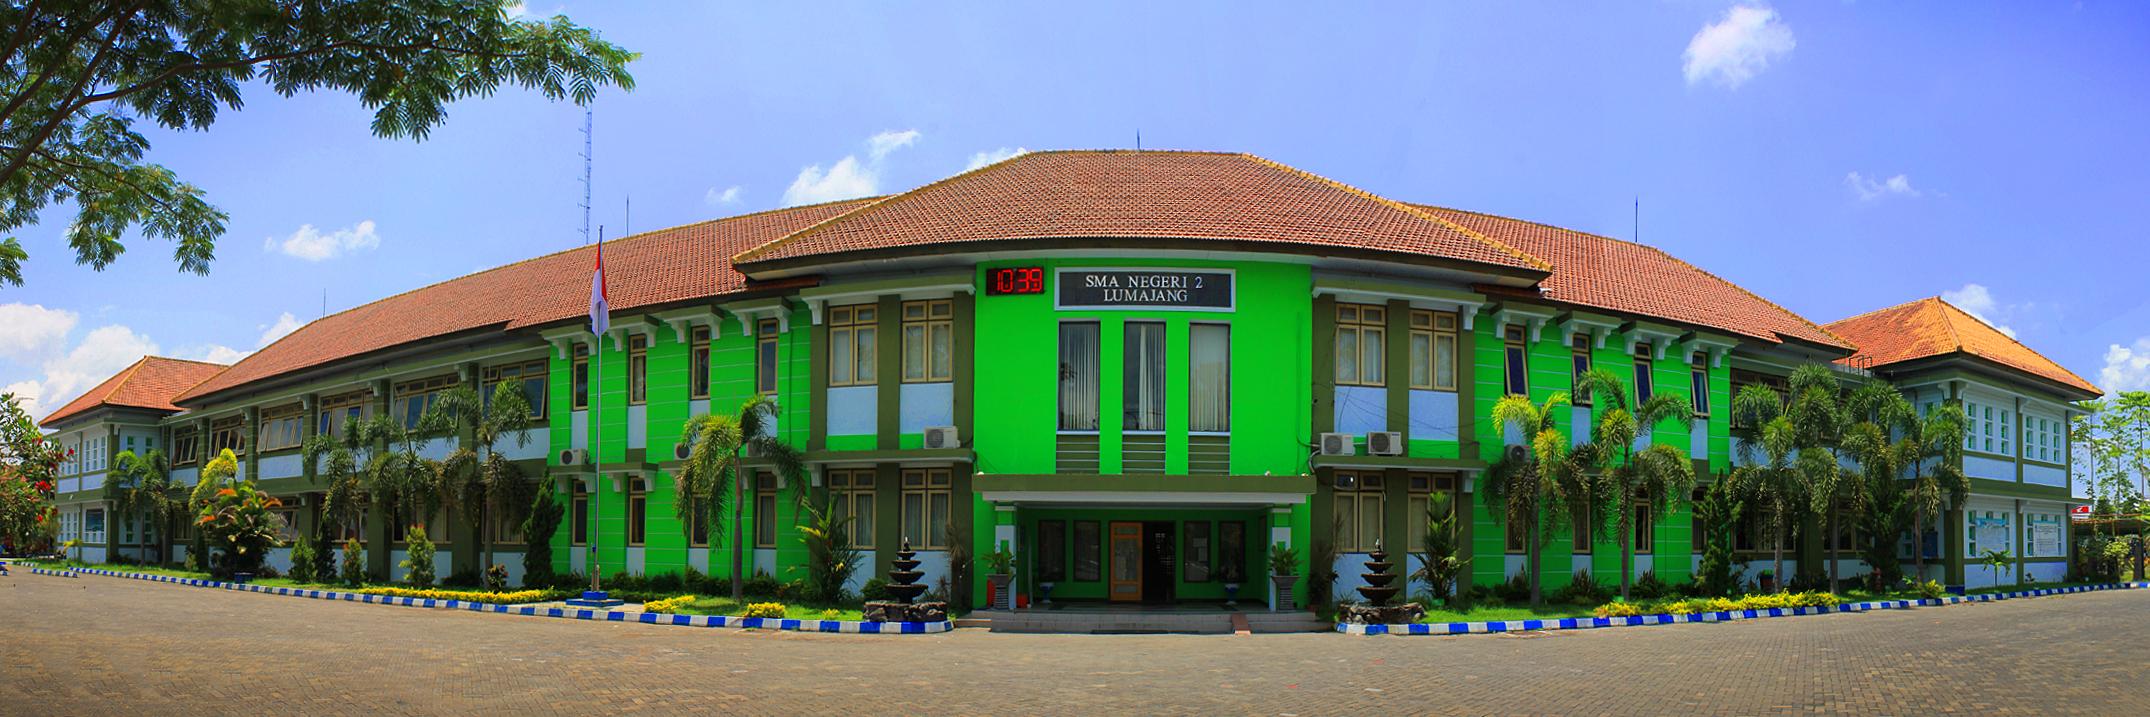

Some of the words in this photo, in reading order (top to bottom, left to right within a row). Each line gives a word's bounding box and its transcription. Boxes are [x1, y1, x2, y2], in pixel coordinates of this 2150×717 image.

[1085, 274, 1120, 288] SMA
[1128, 275, 1188, 289] NEGERI
[1194, 276, 1204, 290] 2
[1103, 289, 1188, 302] LUMAJANG
